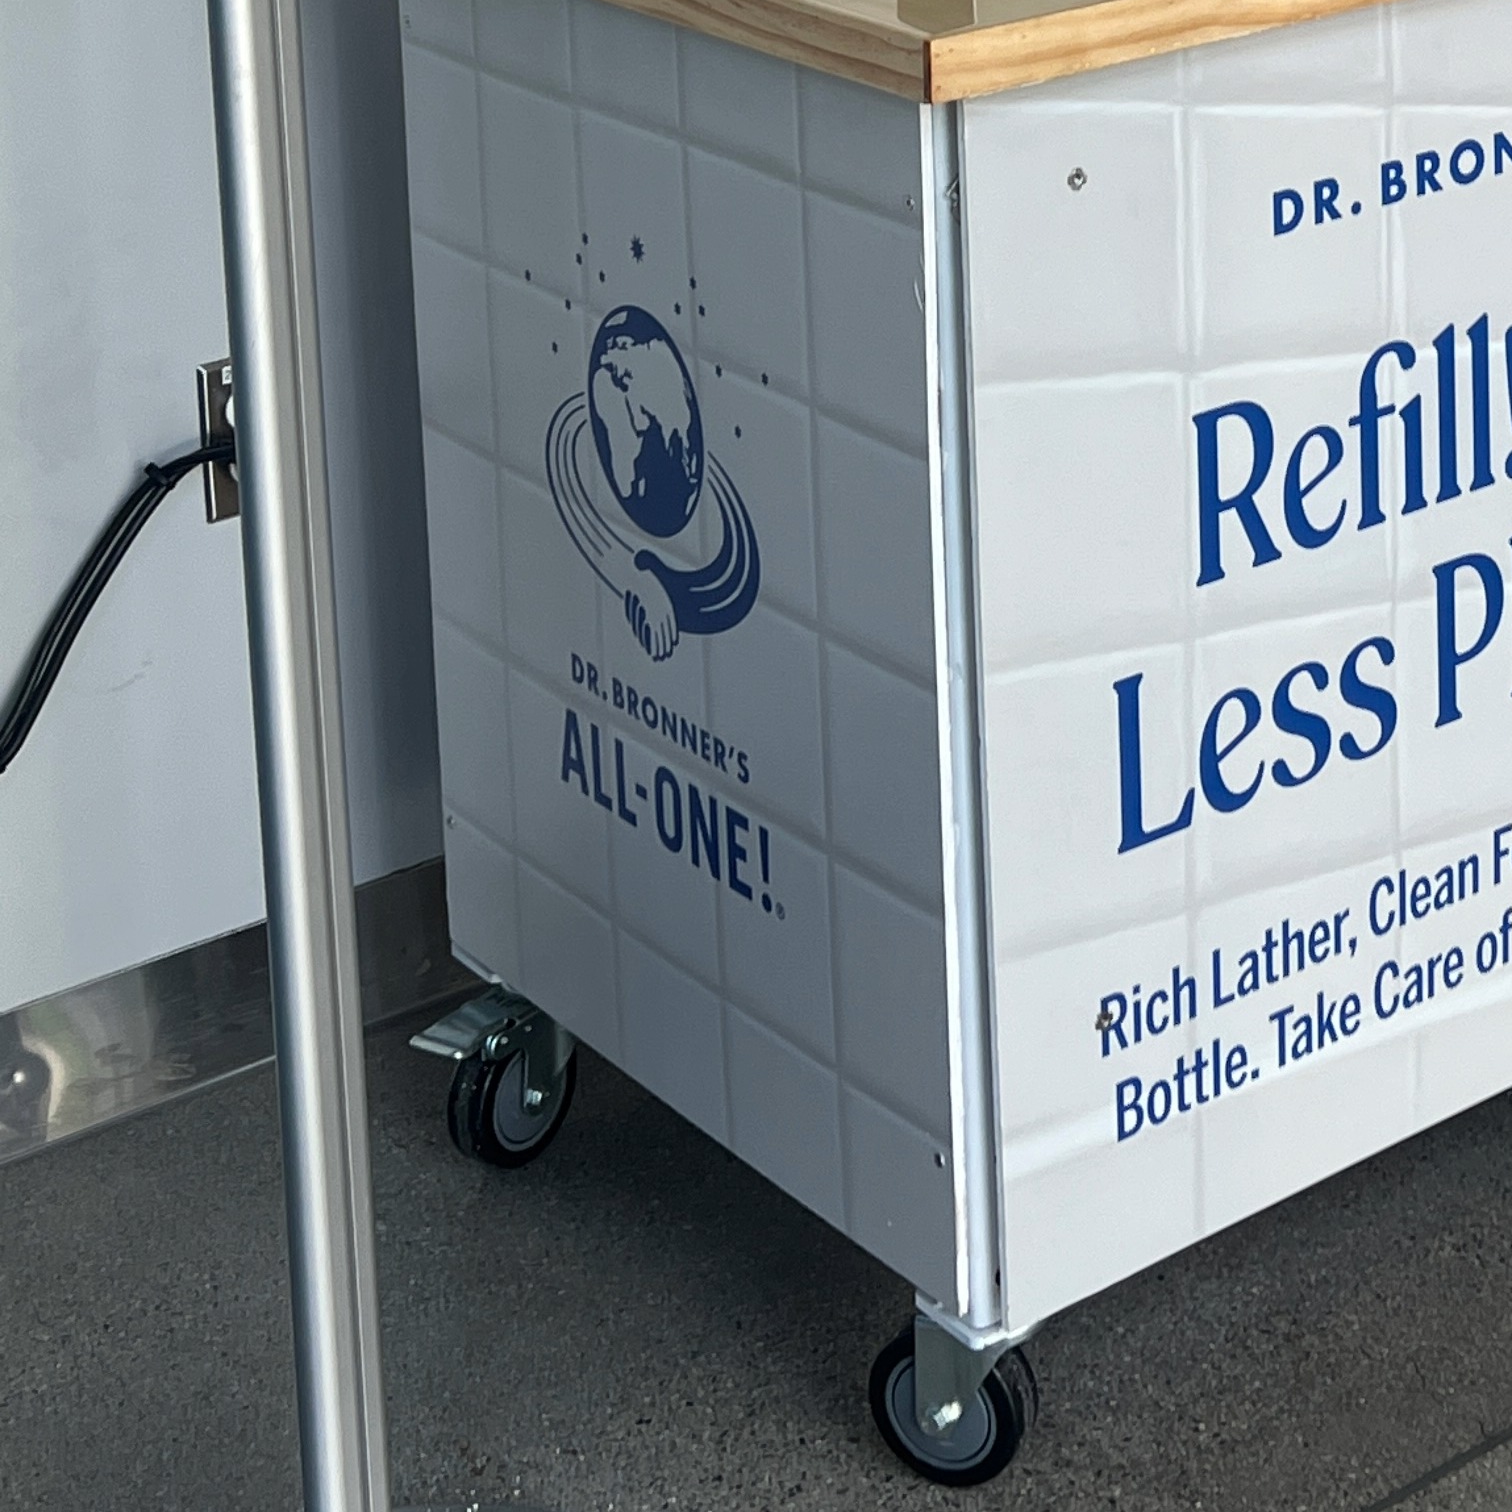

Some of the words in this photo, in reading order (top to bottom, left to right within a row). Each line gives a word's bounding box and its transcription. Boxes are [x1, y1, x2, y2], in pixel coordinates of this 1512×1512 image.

[1272, 178, 1361, 236] DR.
[561, 707, 773, 914] ALL-ONE!
[571, 652, 608, 701] DR.
[611, 676, 750, 784] BRONNER'S
[1113, 636, 1398, 854] Less
[1100, 966, 1197, 1057] Rich
[1212, 908, 1357, 1008] Lather,
[1368, 852, 1480, 936] Clean
[1115, 1038, 1260, 1142] Bottle.
[1268, 985, 1361, 1069] Take
[1373, 949, 1465, 1020] Care
[1476, 910, 1512, 976] of
